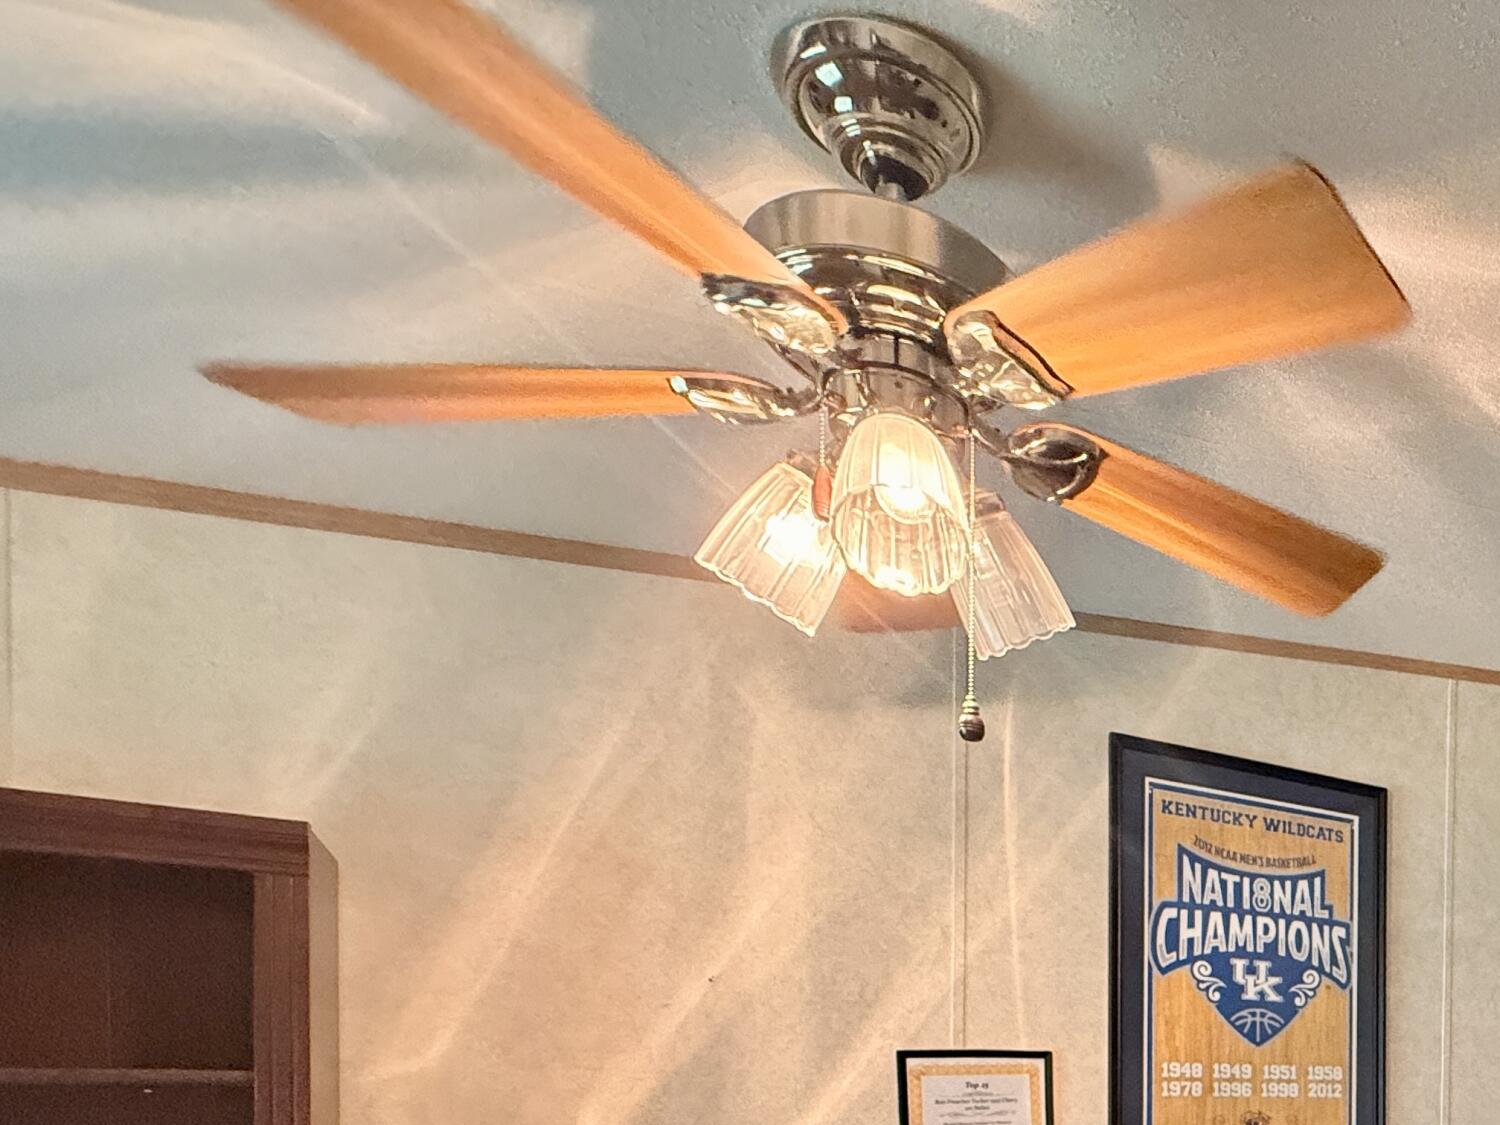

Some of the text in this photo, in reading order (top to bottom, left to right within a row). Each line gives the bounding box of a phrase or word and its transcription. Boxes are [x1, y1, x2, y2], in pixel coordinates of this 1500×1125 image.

[1161, 799, 1344, 843] KENTUCKY WILDCATS
[1193, 835, 1212, 853] 2012
[1213, 847, 1238, 863] NCAA
[1265, 854, 1317, 869] BASKETBALL
[1156, 906, 1348, 985] CHAMPIONS
[1229, 957, 1283, 1003] UK
[965, 1081, 979, 1090] Top
[1161, 1062, 1343, 1081] 1948 1949 1951 1958
[1161, 1081, 1343, 1098] 1978 1996 1998 2012
